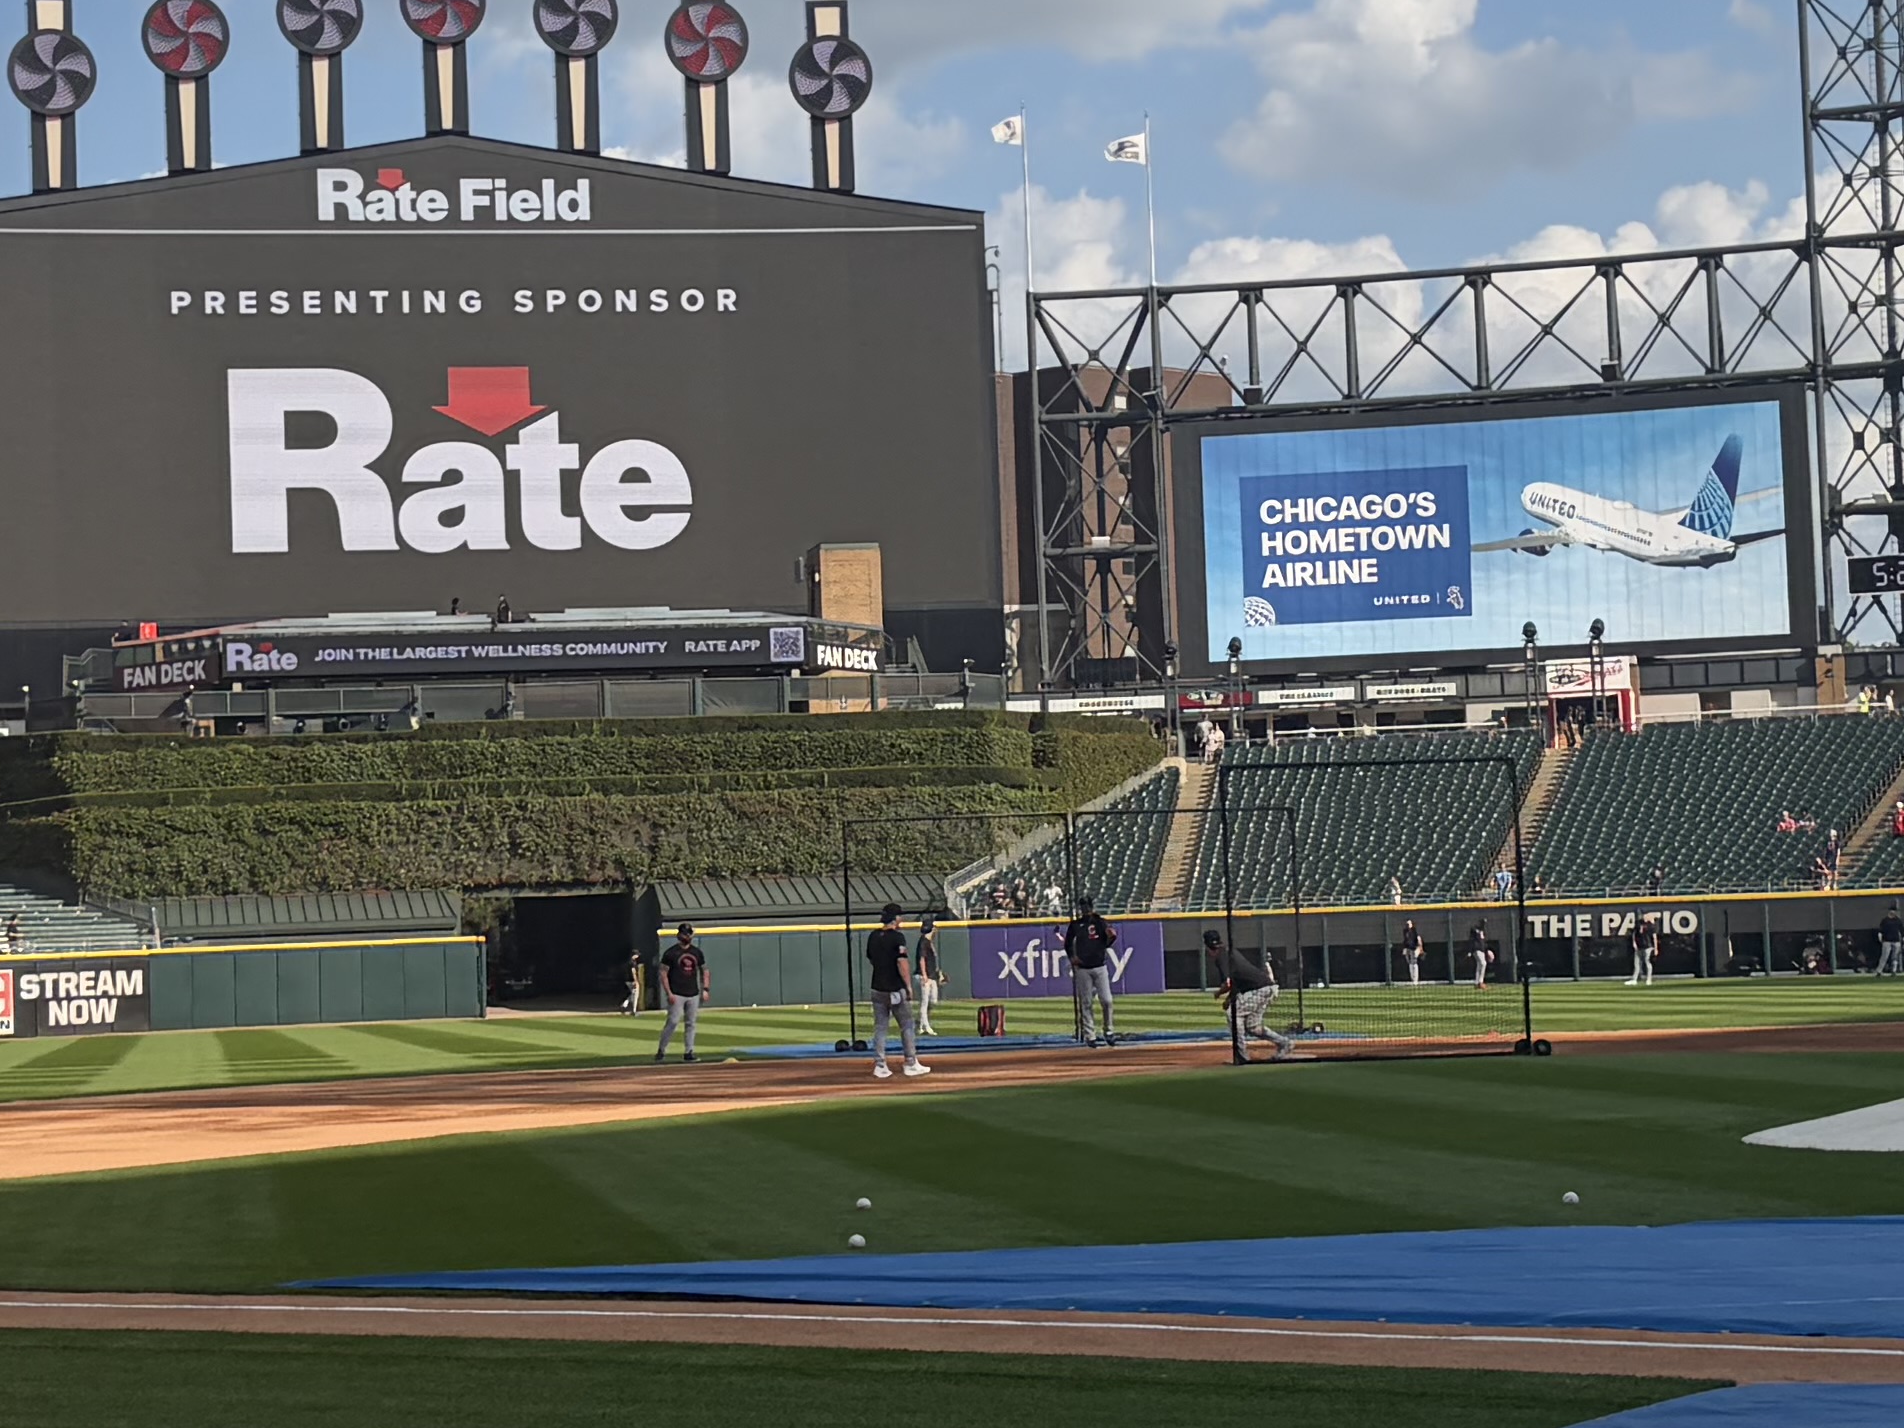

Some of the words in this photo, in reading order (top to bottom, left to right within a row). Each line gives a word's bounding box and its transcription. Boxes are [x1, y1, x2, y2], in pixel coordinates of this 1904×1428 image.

[316, 168, 448, 223] Rate
[460, 178, 590, 223] Field
[170, 290, 483, 315] PRESENTING
[514, 287, 739, 313] SPONSOR
[227, 368, 692, 553] Rate
[1259, 491, 1437, 526] CHICAGO'S
[1529, 491, 1576, 519] UNITED
[1260, 524, 1450, 557] HOMETOWN
[1262, 558, 1378, 589] AIRLINE
[1374, 594, 1430, 605] UNITED
[226, 643, 298, 671] Rate
[314, 647, 353, 662] JOIN
[357, 647, 390, 660] THE
[393, 646, 469, 659] LARGEST
[473, 643, 562, 658] WELLNESS
[566, 641, 667, 655] COMMUNITY
[685, 640, 727, 653] RATE
[729, 640, 761, 652] APP
[816, 645, 843, 668] FAN
[844, 647, 878, 671] DECK
[123, 667, 159, 689] FAN
[161, 660, 206, 685] DECK
[1527, 914, 1592, 938] THE
[1602, 910, 1698, 937] PAIO
[998, 938, 1134, 986] xfiny
[20, 970, 143, 1000] STREAM
[49, 998, 117, 1026] NOW
